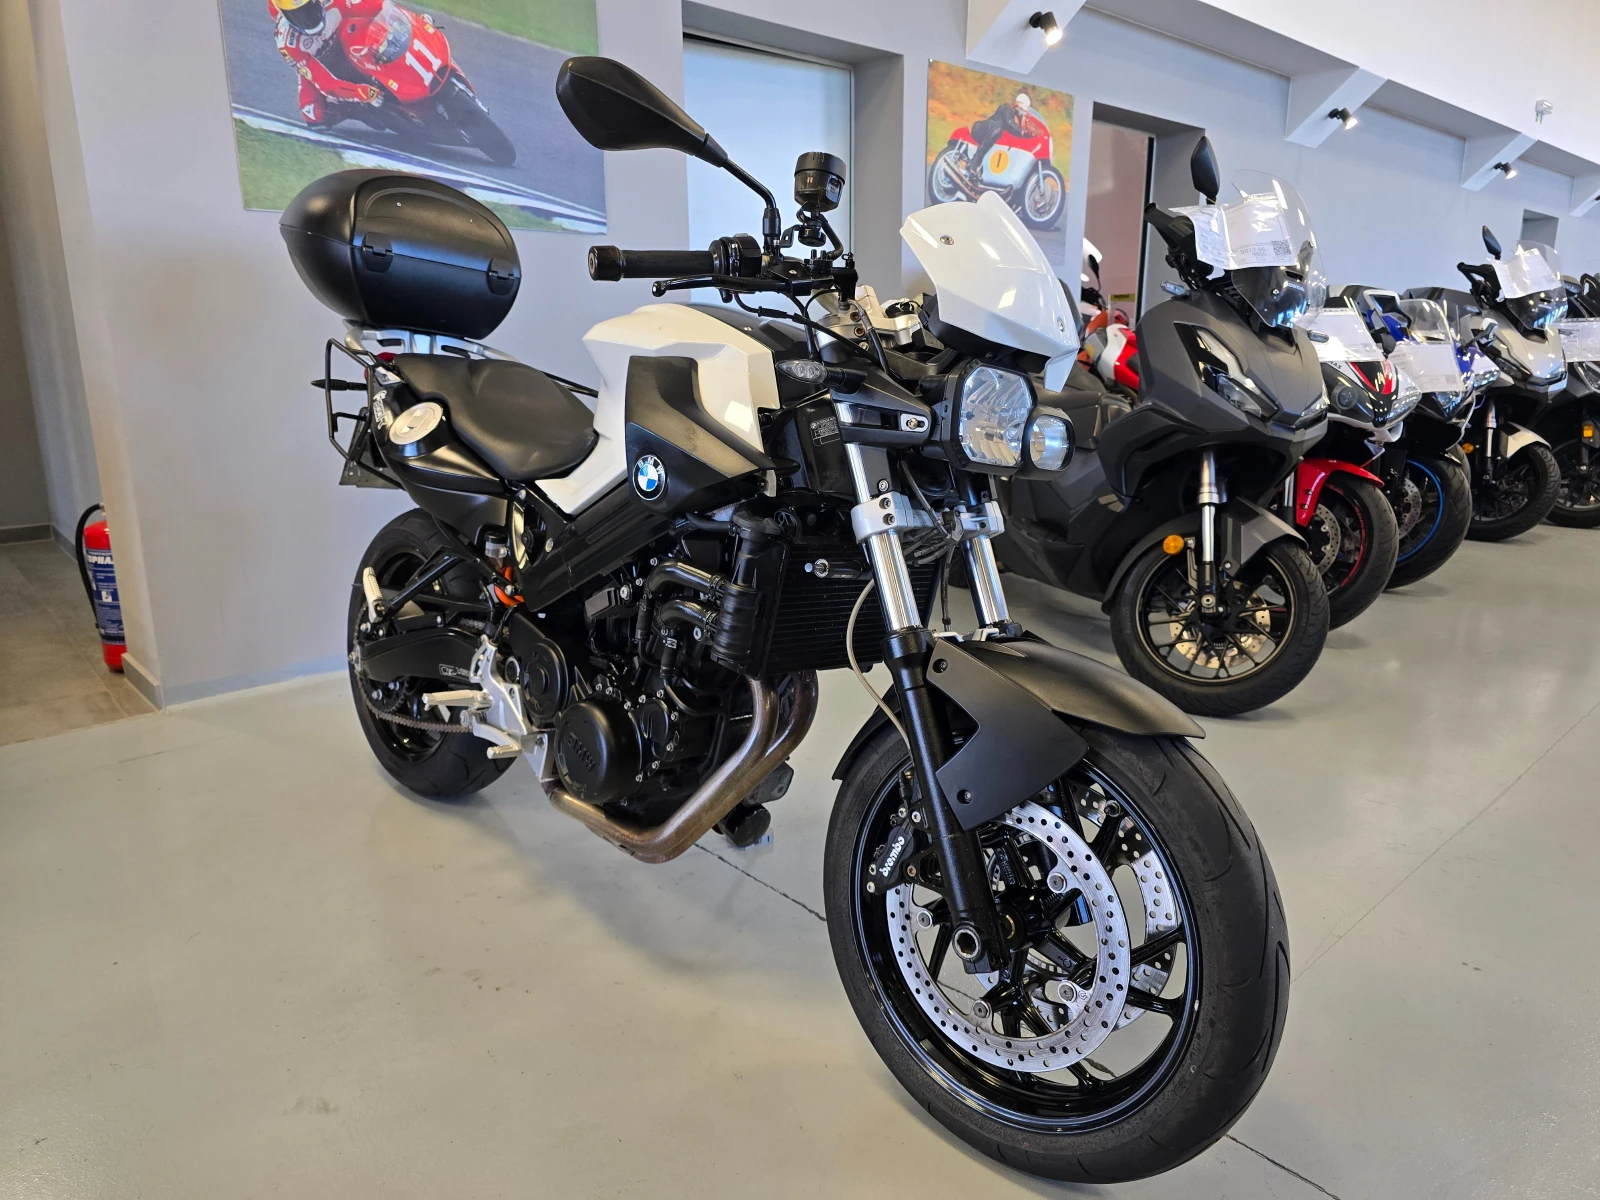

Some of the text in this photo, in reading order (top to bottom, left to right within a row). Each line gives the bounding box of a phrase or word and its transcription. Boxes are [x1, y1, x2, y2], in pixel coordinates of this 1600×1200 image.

[404, 38, 442, 87] 11
[996, 152, 1002, 169] 1
[567, 731, 597, 773] BMW
[879, 835, 905, 878] brembo
